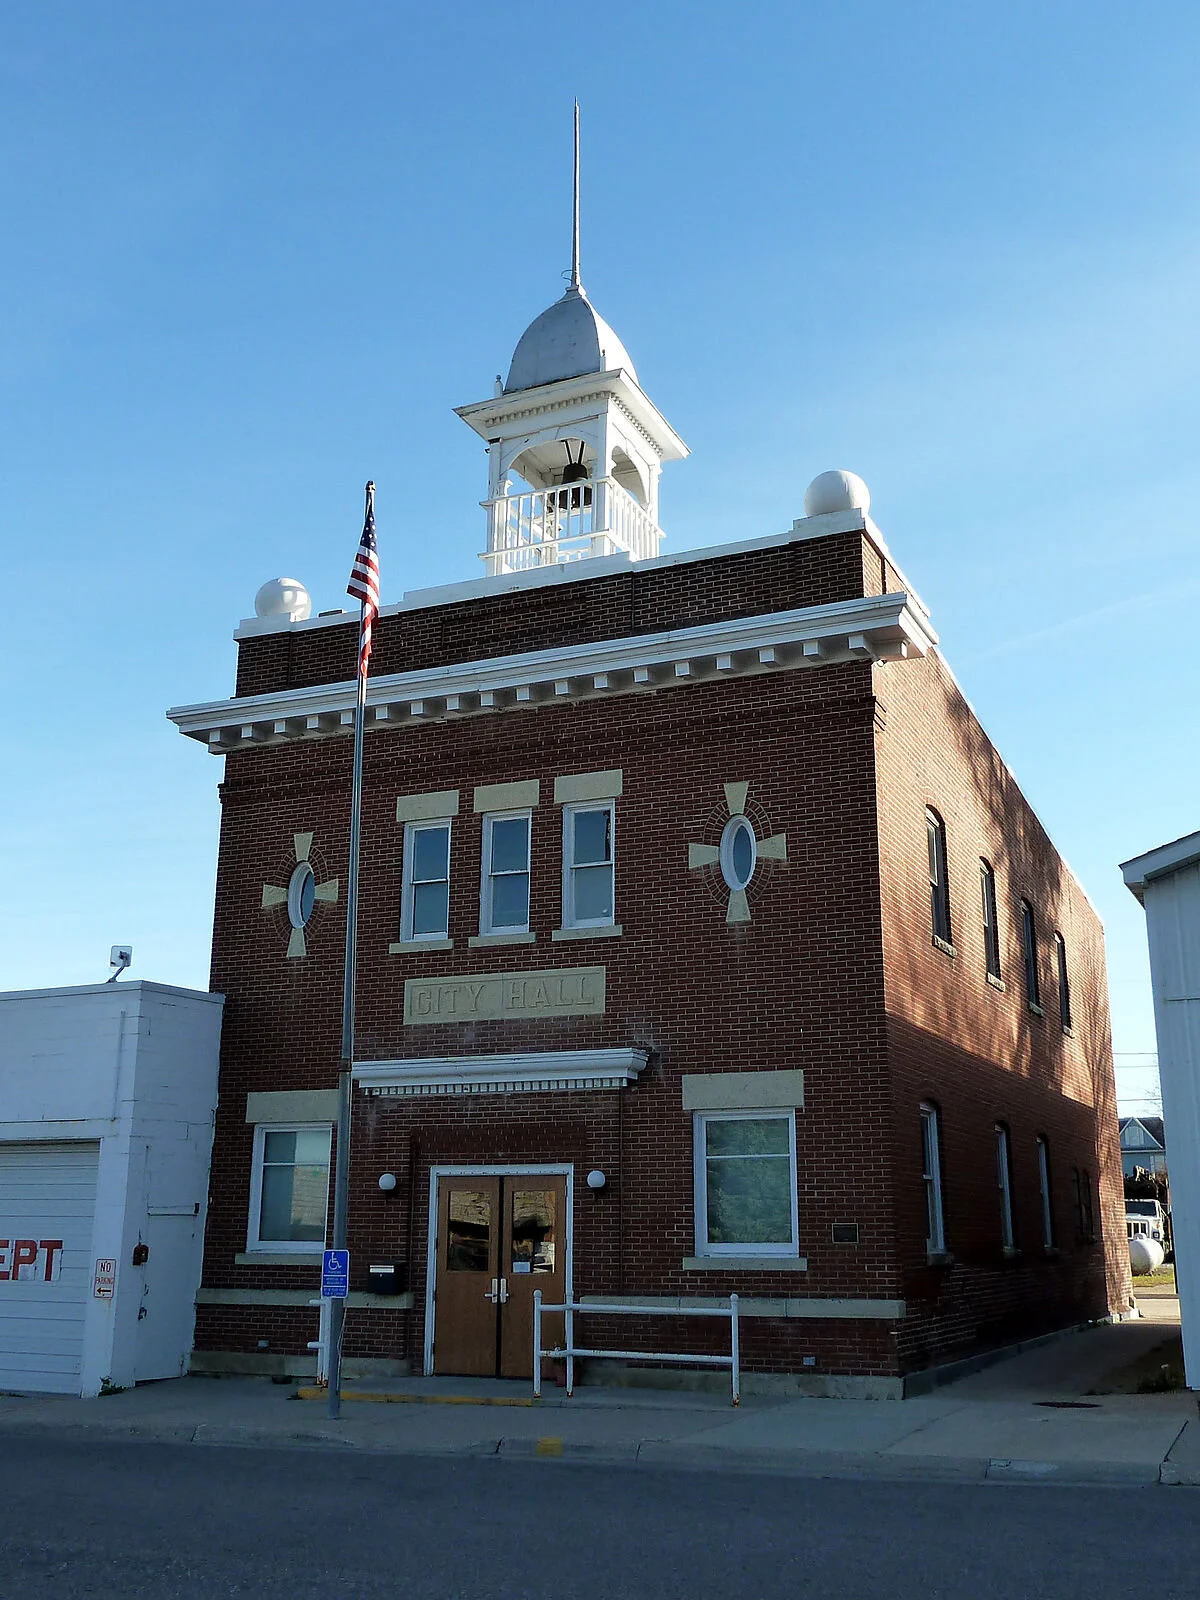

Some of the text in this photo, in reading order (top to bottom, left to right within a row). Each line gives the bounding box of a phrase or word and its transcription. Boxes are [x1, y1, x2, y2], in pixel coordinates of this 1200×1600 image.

[417, 976, 595, 1015] CITY HALL
[100, 1262, 111, 1272] NO
